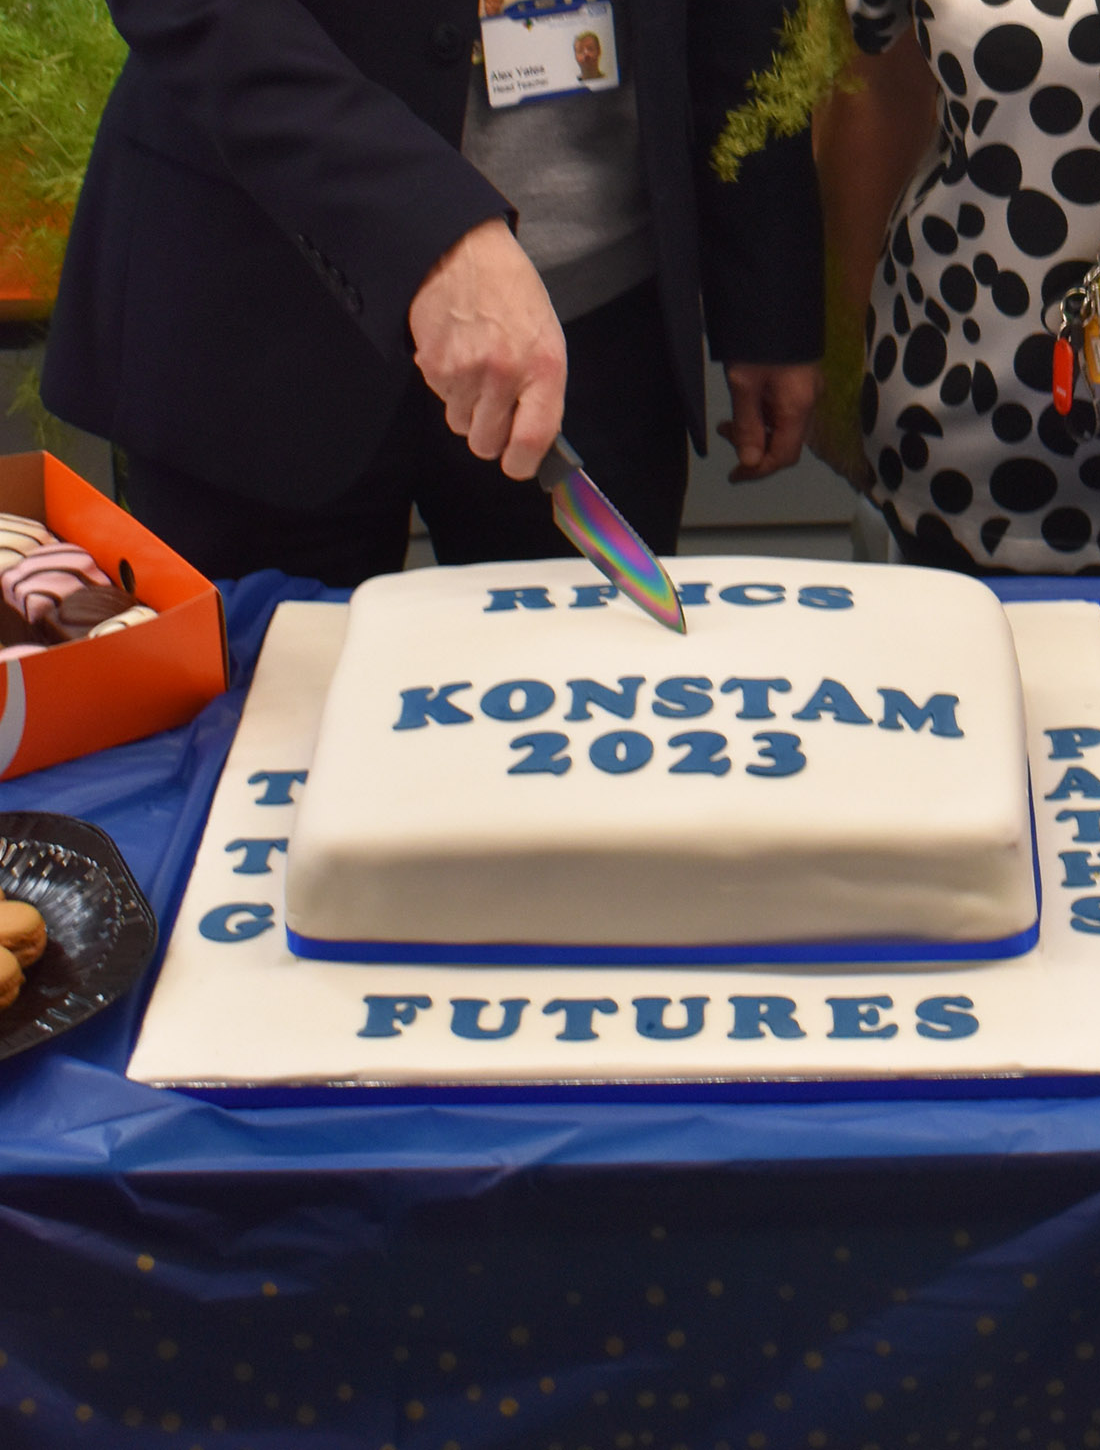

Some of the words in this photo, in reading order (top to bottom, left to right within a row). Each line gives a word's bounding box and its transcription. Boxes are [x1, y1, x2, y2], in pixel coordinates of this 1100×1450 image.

[393, 676, 965, 739] KONSTAM
[507, 731, 808, 778] 2023
[356, 994, 980, 1042] FUTURES
